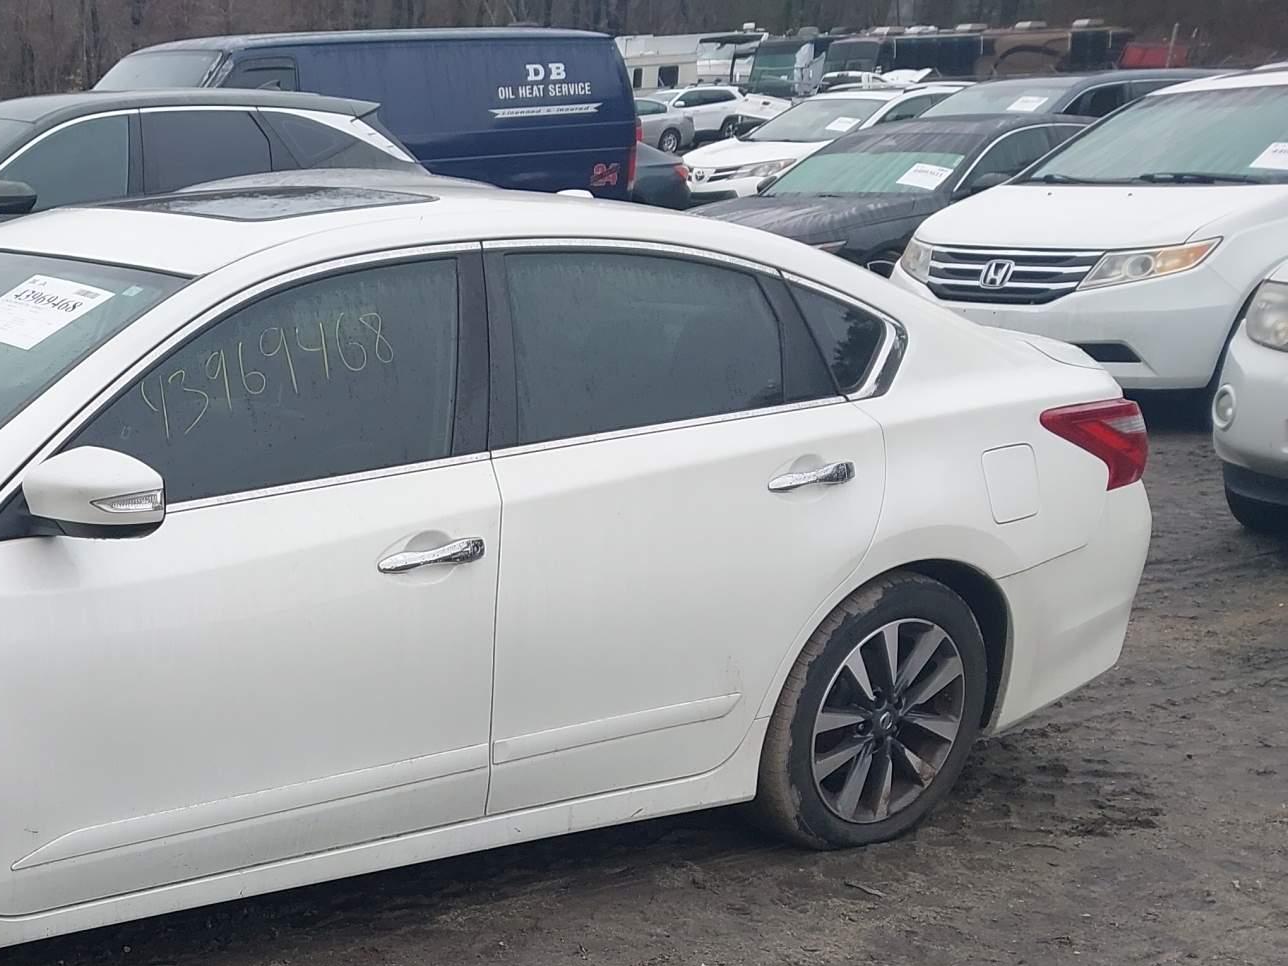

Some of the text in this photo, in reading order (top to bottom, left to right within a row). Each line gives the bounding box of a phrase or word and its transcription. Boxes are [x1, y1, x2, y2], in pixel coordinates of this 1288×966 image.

[498, 82, 592, 100] OIL HEAT SERVICE
[13, 288, 85, 314] 43969468
[140, 311, 395, 440] 43969468
